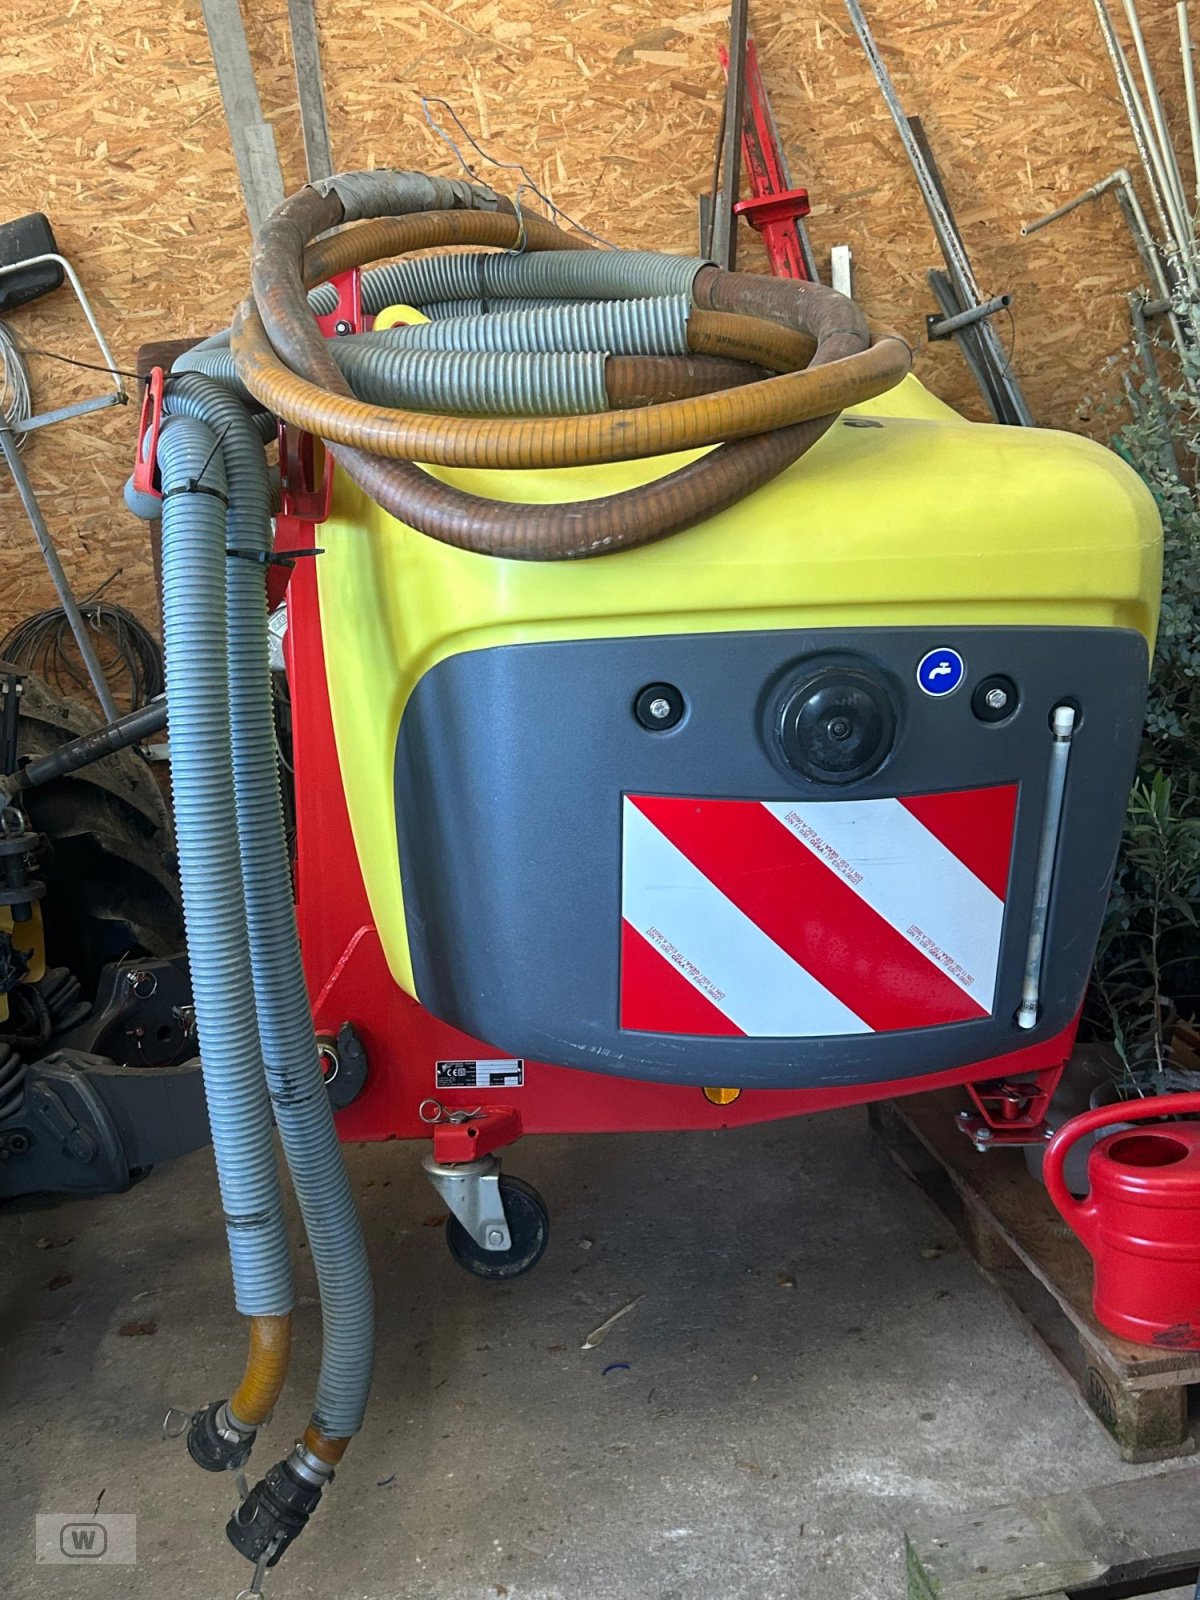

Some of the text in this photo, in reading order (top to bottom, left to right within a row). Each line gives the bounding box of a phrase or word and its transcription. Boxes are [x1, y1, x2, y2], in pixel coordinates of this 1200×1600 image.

[806, 828, 816, 838] ESC
[785, 815, 794, 824] DIN
[799, 828, 809, 838] 030
[810, 839, 824, 853] GEKA
[832, 860, 842, 870] ESC
[825, 845, 839, 858] GEKA
[840, 859, 849, 868] 030
[853, 872, 863, 881] DIN
[667, 943, 678, 953] ESC
[646, 930, 656, 939] DIN
[671, 954, 686, 968] GEKA
[694, 976, 704, 986] ESC
[929, 948, 941, 960] GEKA
[942, 952, 954, 964] GEKA
[686, 961, 700, 974] GEKA
[716, 989, 725, 998] DIN
[447, 1068, 458, 1077] CE
